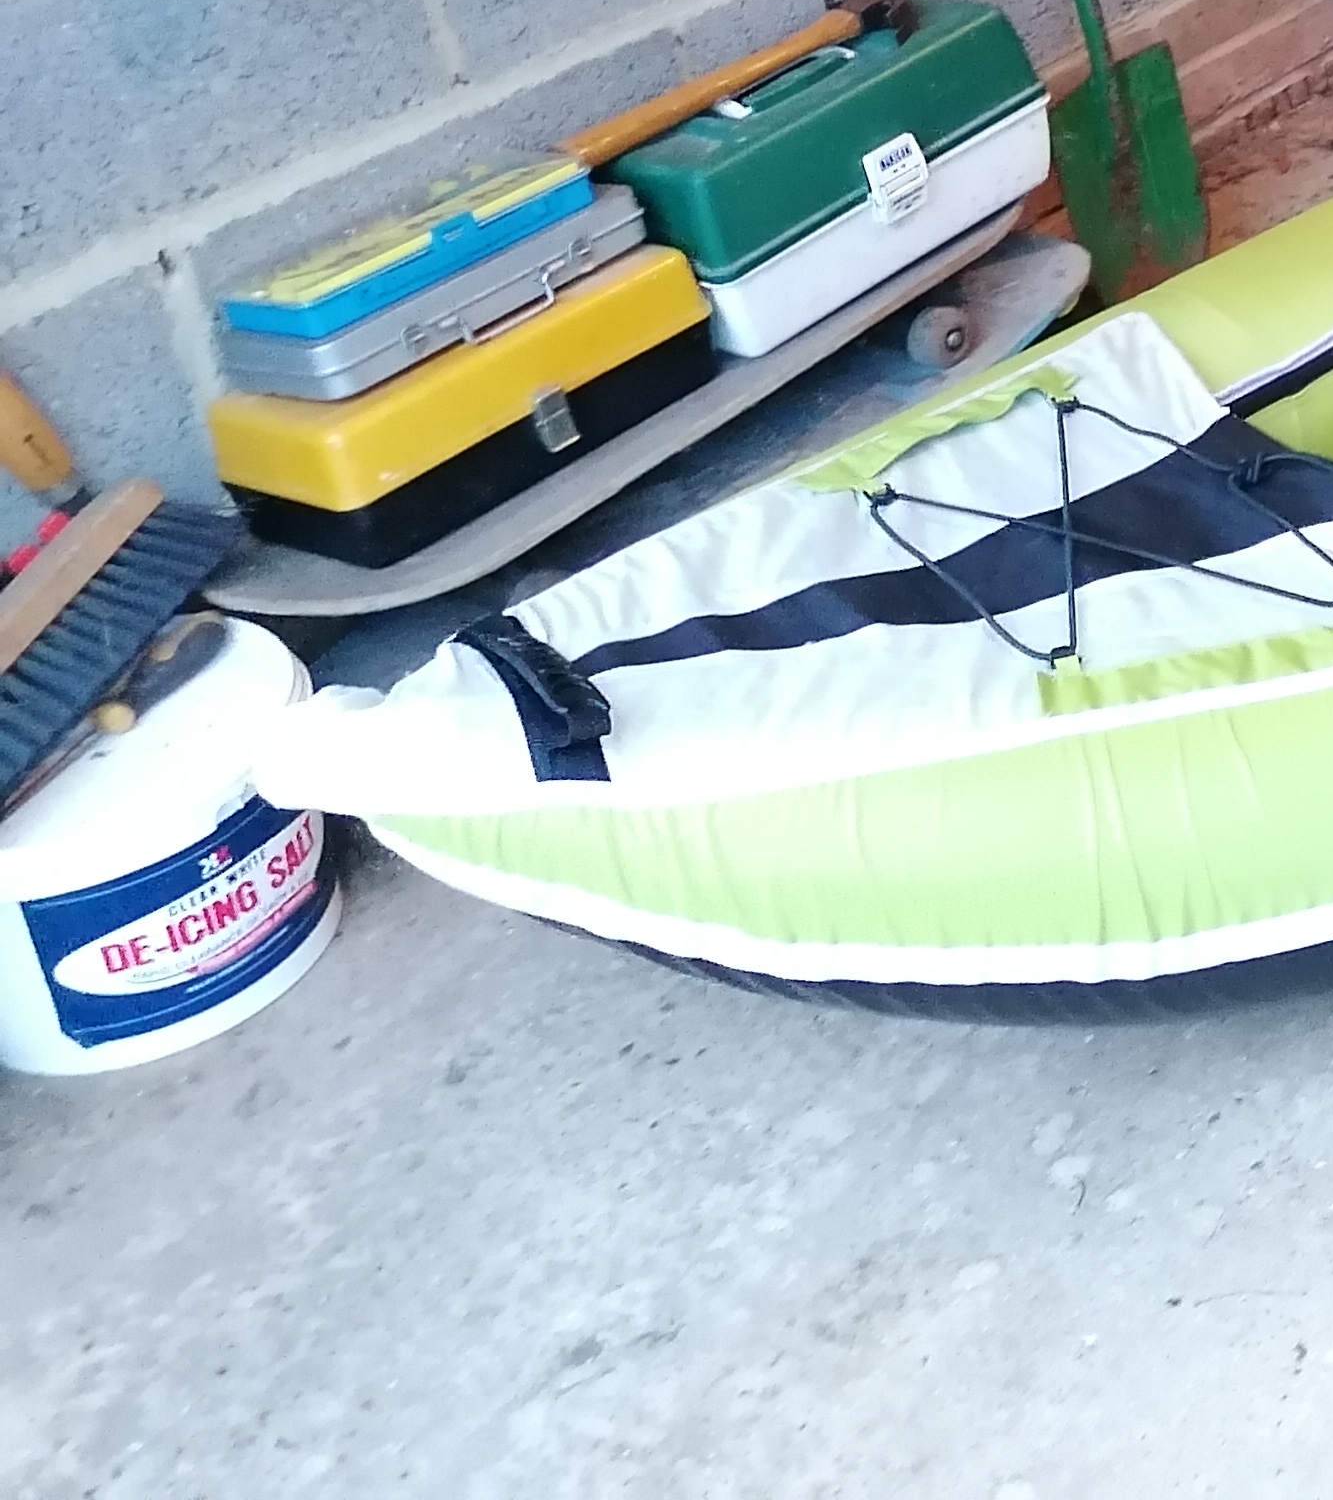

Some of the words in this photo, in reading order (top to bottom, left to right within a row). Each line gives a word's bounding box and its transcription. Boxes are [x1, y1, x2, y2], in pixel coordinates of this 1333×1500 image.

[100, 880, 259, 974] DE-ICING
[266, 815, 314, 889] SALT
[169, 886, 219, 917] CLEAR
[225, 848, 267, 887] WHITE
